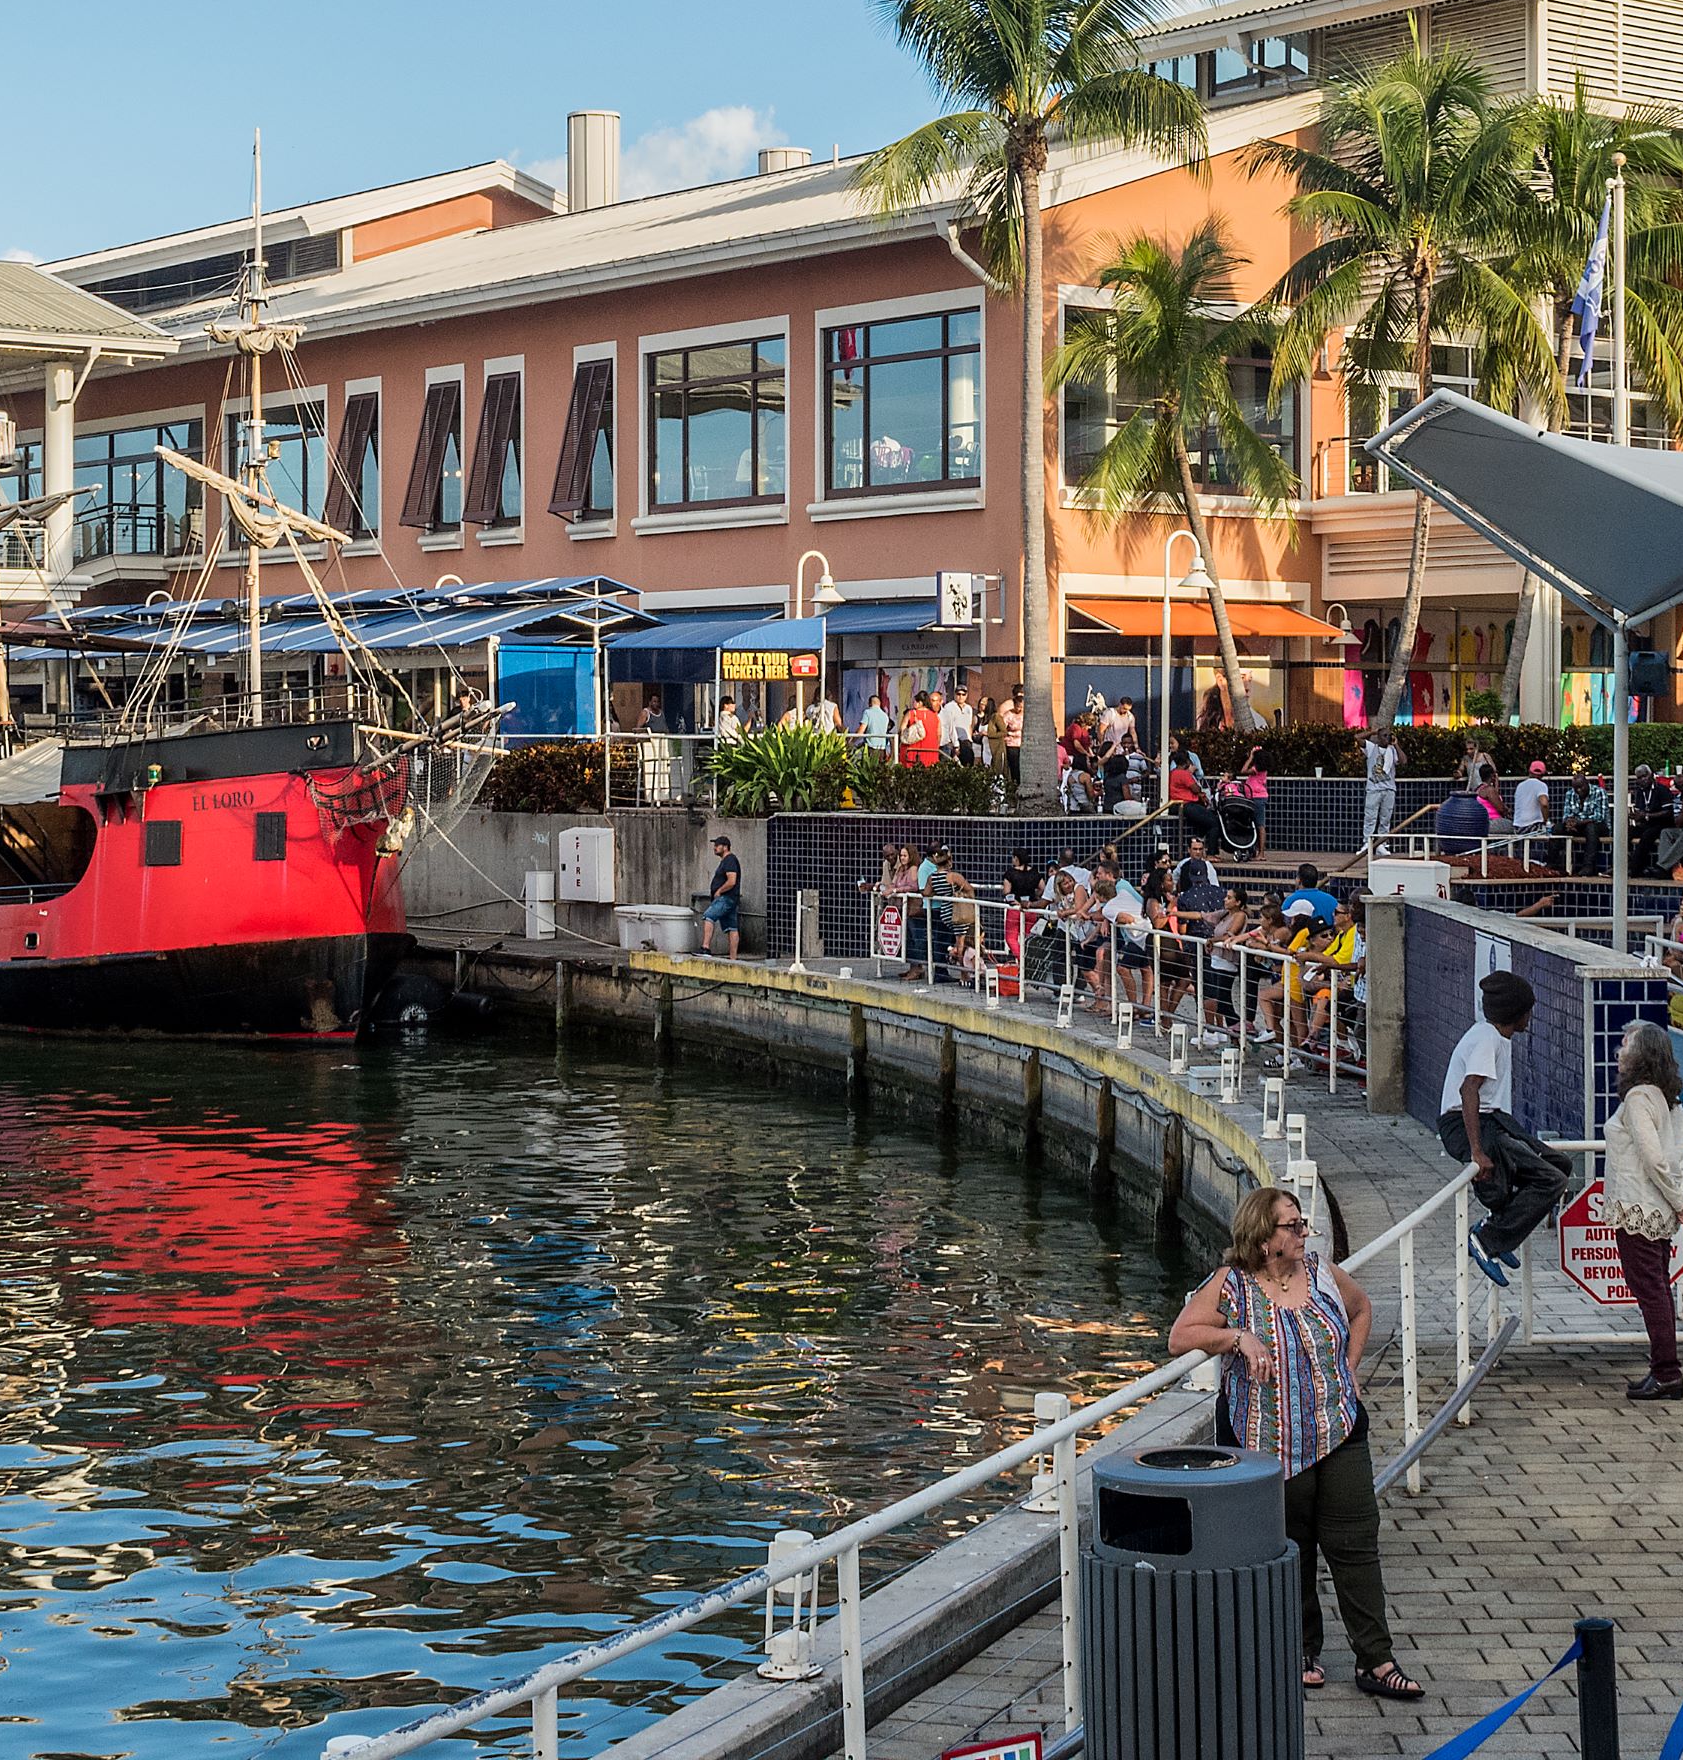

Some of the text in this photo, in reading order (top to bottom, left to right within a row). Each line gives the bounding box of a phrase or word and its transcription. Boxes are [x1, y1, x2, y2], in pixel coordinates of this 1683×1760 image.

[722, 652, 789, 665] BOAT TOUR
[722, 665, 763, 679] TICKETS
[765, 665, 789, 679] HERE
[192, 790, 255, 812] EL LORO
[884, 911, 898, 924] STOP
[1571, 1247, 1621, 1260] PERSON
[1583, 1266, 1625, 1280] BEYON
